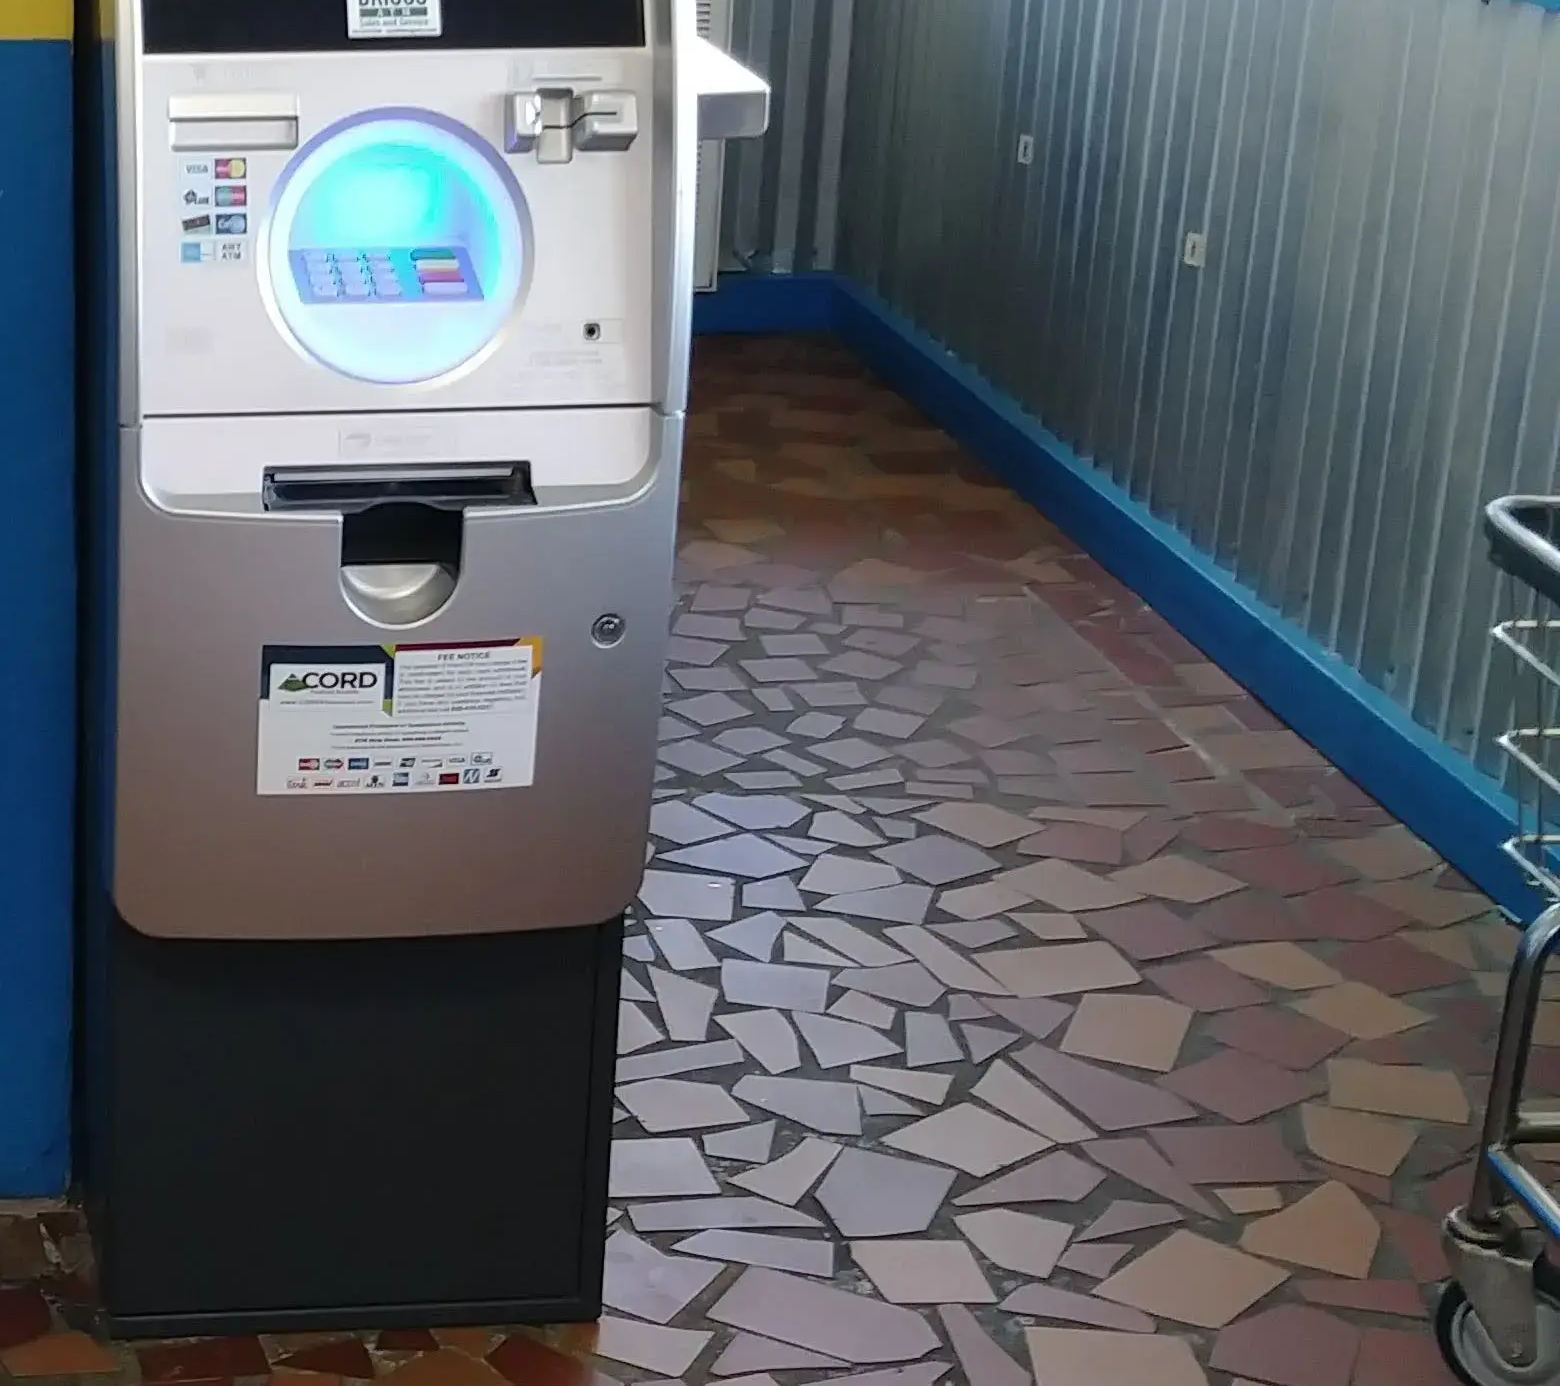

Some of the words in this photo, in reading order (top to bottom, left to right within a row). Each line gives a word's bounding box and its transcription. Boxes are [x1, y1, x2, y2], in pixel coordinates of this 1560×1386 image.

[185, 164, 209, 174] VISA
[437, 653, 456, 662] FEE
[457, 651, 491, 661] NOTICE
